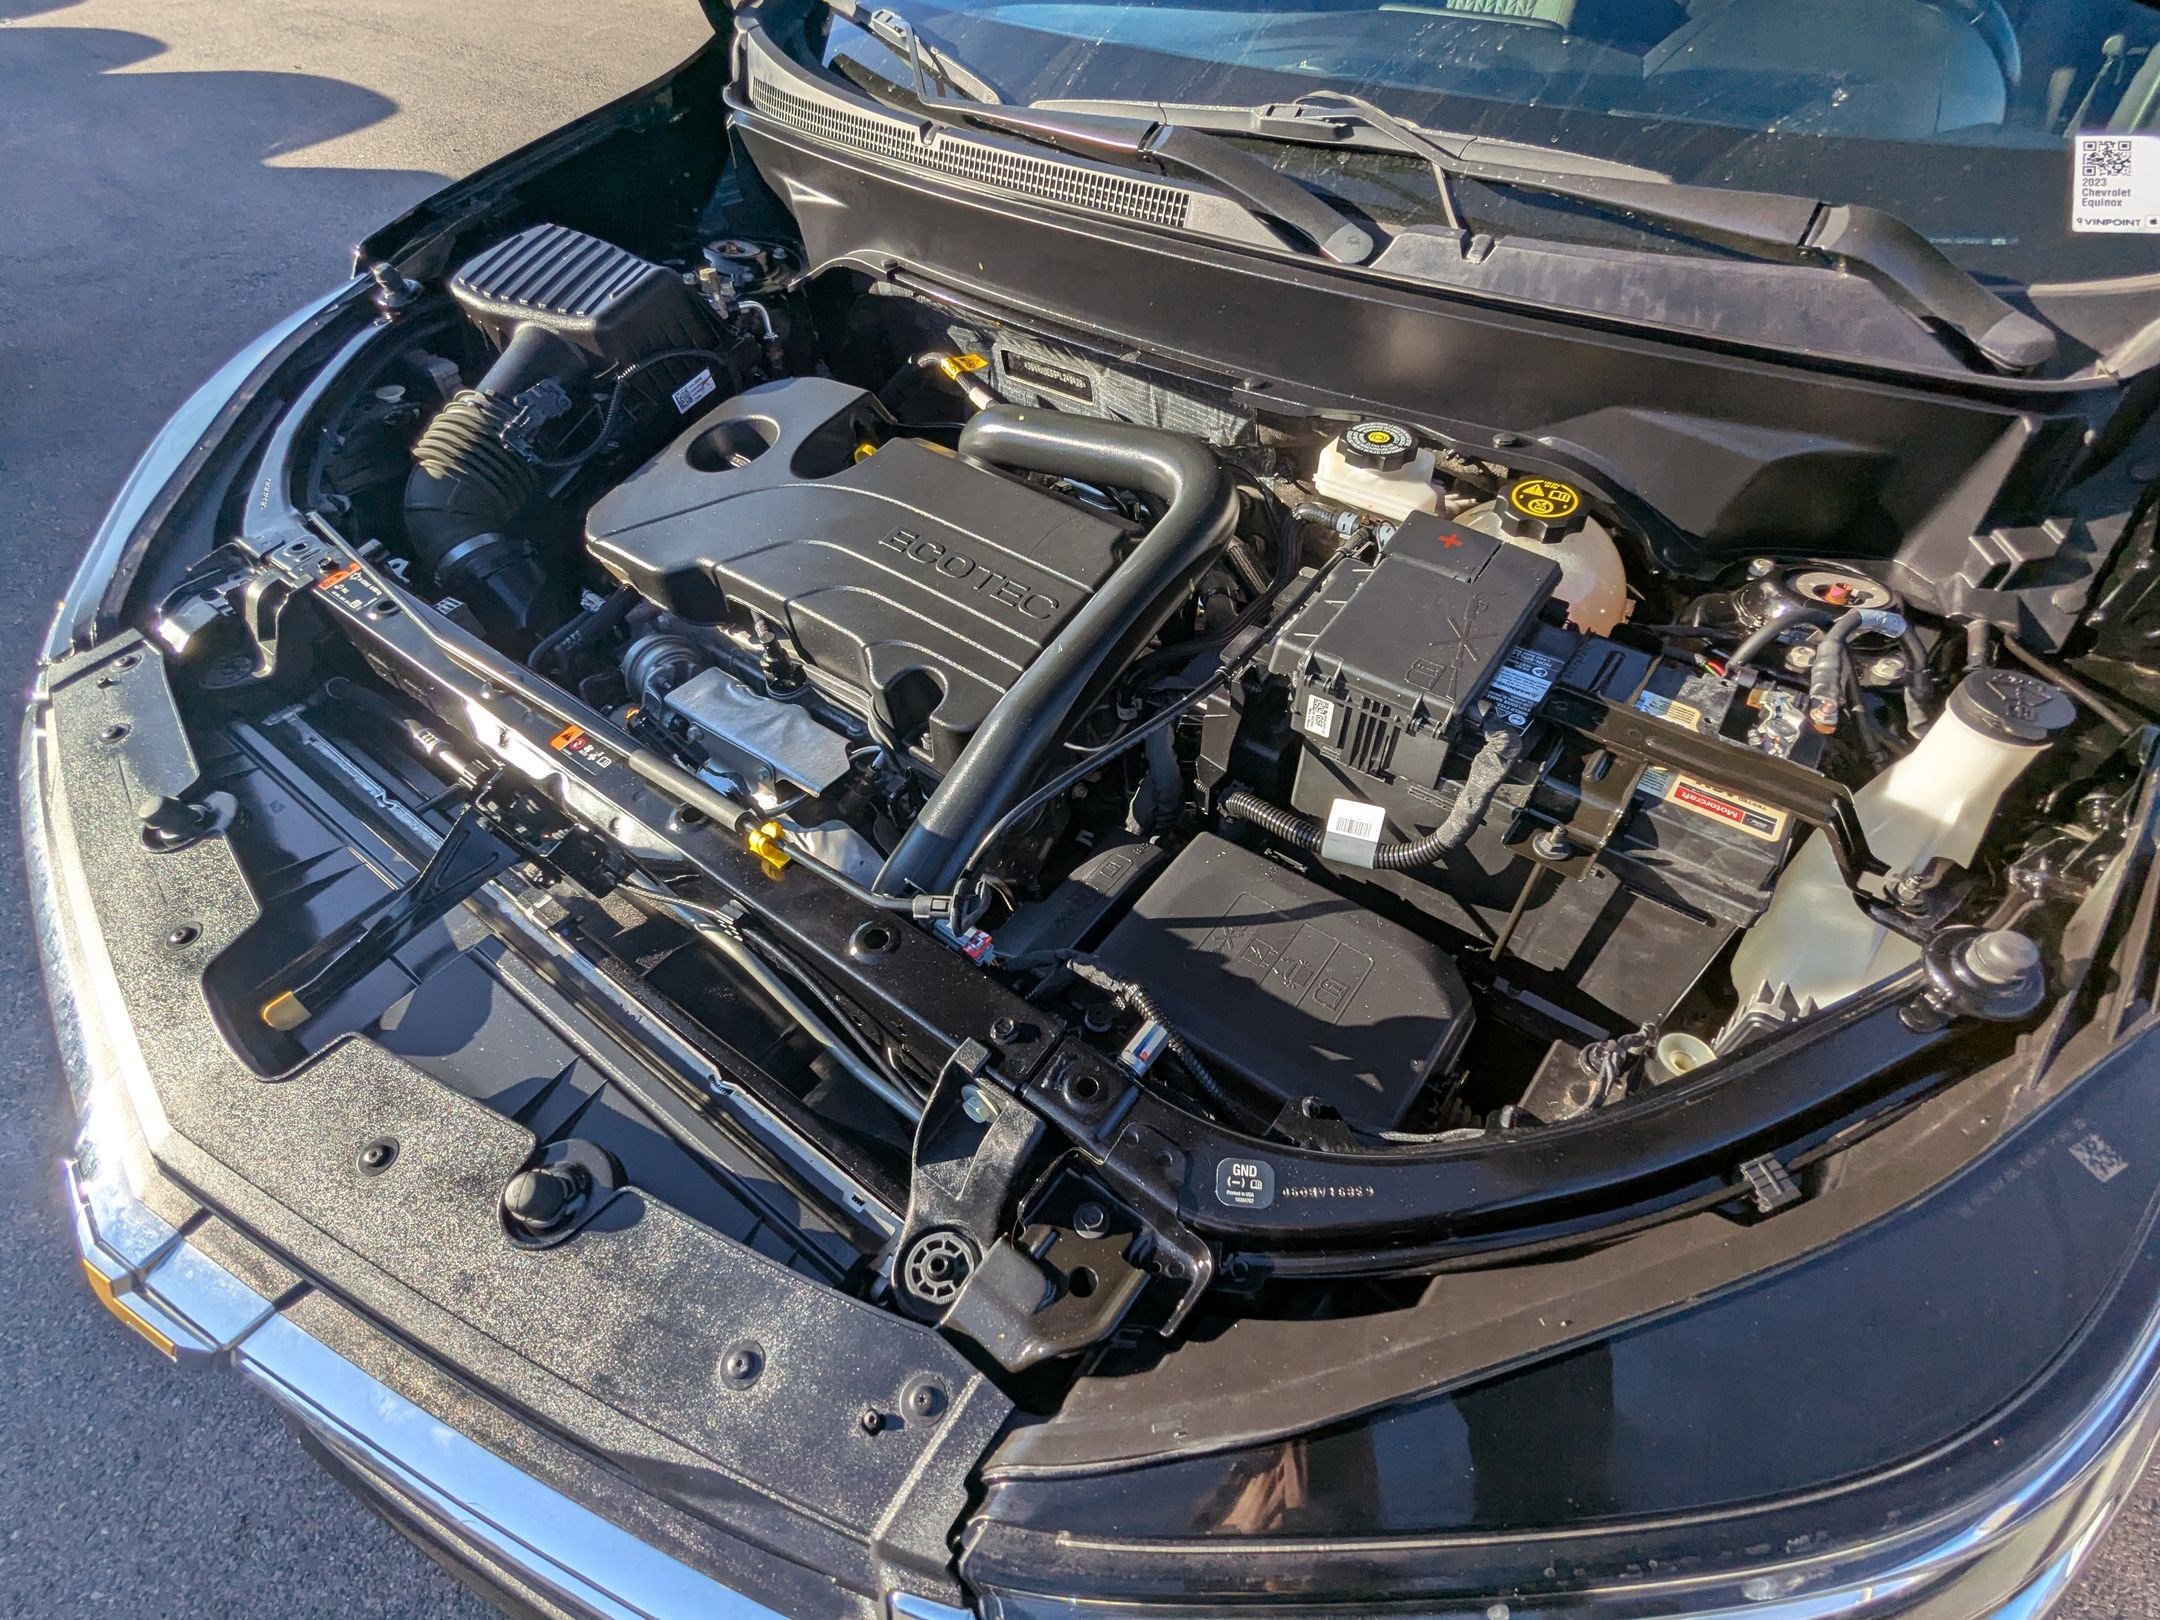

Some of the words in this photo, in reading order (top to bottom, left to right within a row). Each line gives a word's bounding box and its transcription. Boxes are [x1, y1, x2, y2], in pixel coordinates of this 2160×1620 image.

[2082, 177, 2107, 187] 2023
[2081, 188, 2131, 197] Chevrolet
[2081, 197, 2122, 208] Equinox
[878, 526, 1060, 620] ECOTEC
[1680, 790, 1738, 818] Motorcraft
[1232, 1164, 1257, 1177] GND
